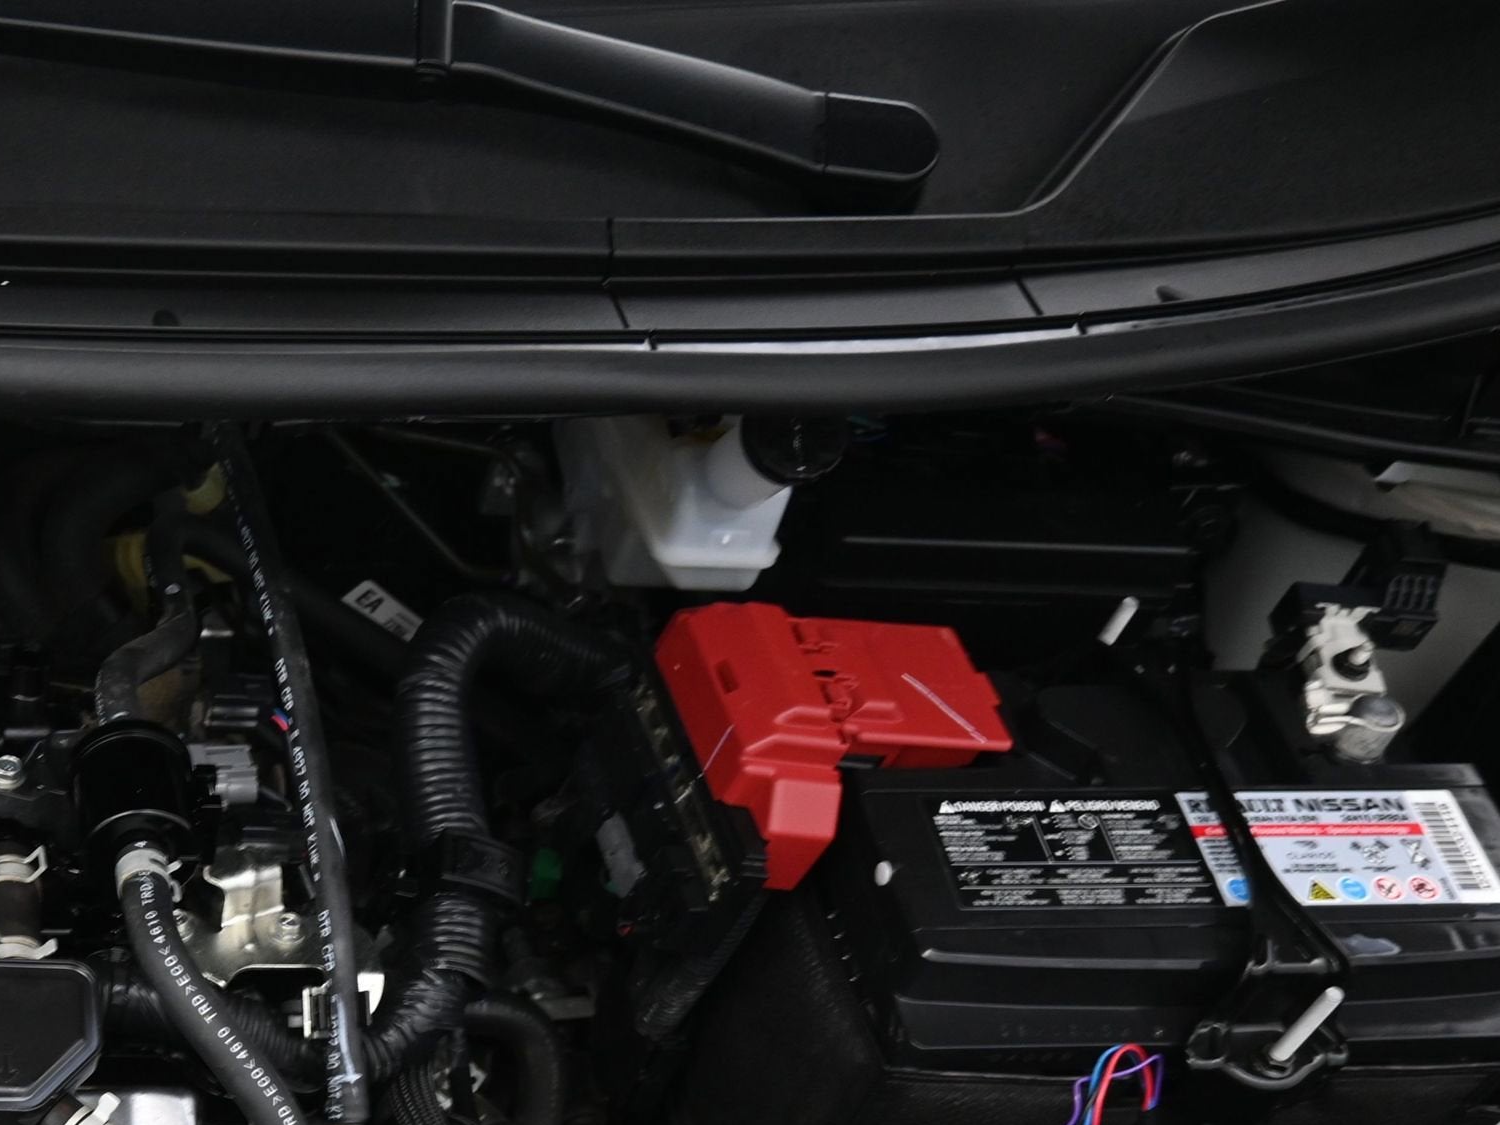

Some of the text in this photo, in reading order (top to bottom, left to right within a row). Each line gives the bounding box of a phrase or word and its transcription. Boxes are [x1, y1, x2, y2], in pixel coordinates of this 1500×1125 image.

[355, 588, 385, 614] EA
[302, 801, 316, 828] NOT
[1293, 798, 1405, 812] NISSAN
